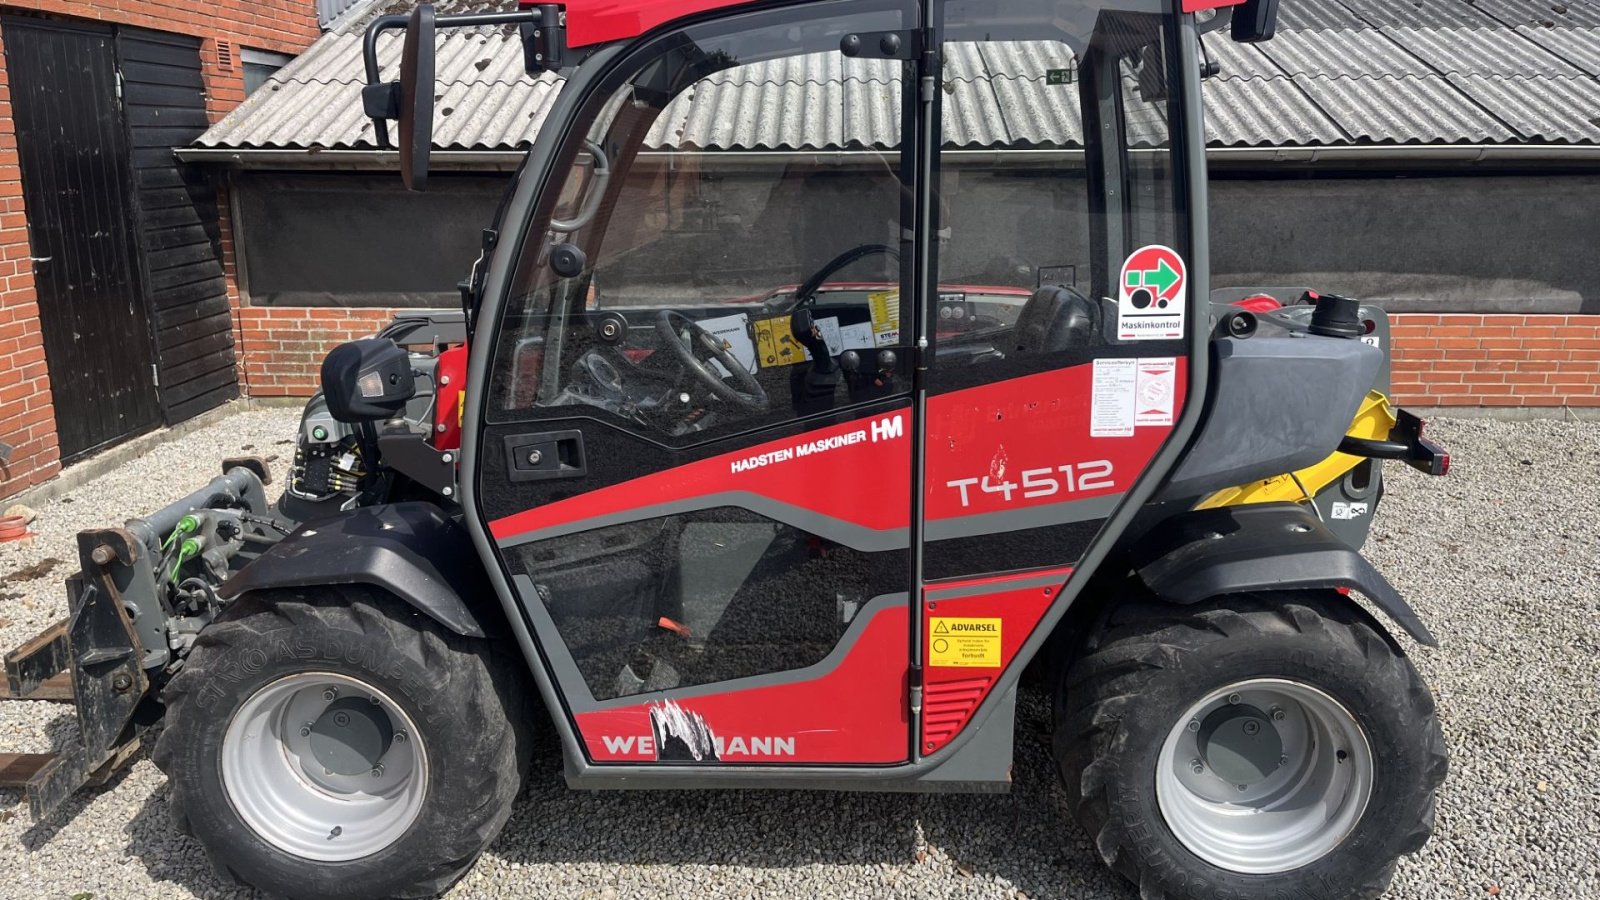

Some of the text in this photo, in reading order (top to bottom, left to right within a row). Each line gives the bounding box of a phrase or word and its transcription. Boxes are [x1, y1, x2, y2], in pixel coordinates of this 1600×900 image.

[1121, 321, 1180, 329] Maskinkontrol
[731, 448, 793, 473] HADSTEN
[796, 430, 866, 457] MASKINER
[871, 415, 903, 443] HM
[946, 459, 1115, 507] T4512
[951, 623, 996, 631] ADVARSEL
